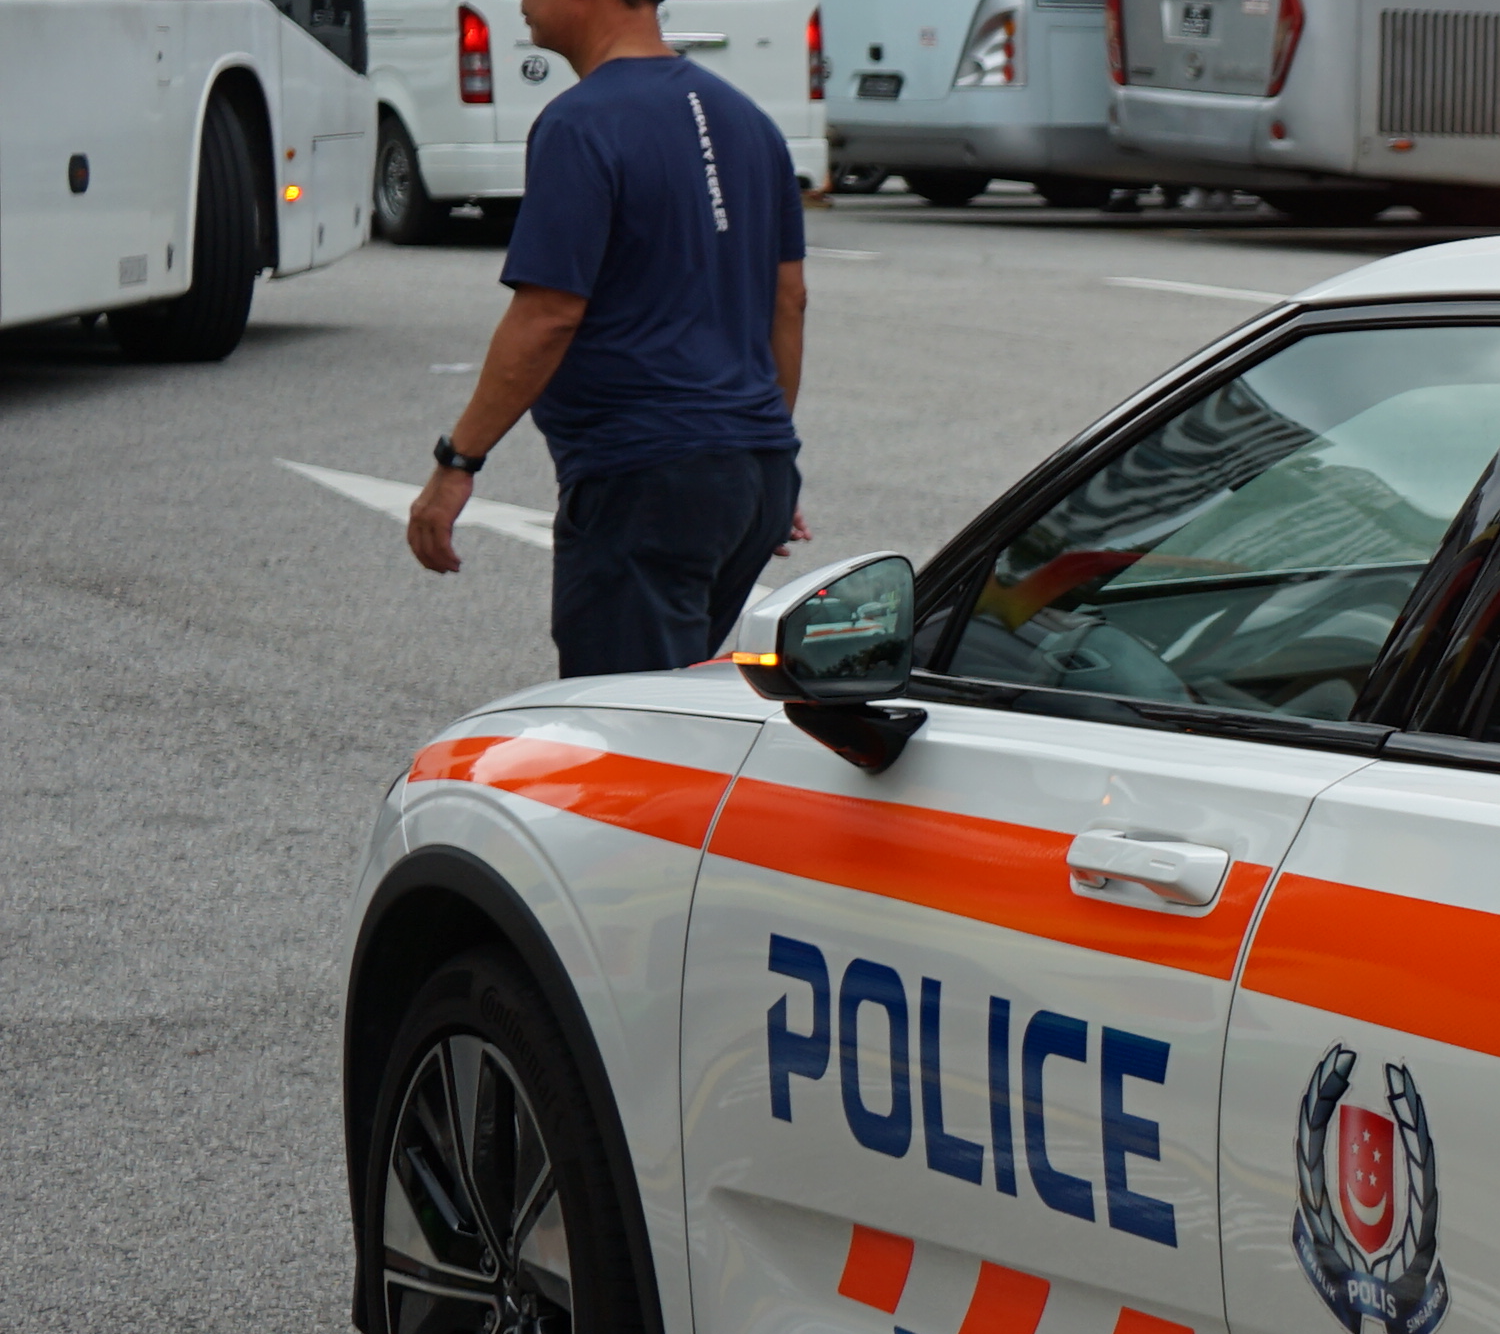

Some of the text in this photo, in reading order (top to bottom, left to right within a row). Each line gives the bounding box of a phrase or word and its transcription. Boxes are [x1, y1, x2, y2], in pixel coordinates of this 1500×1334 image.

[704, 163, 729, 233] KEPLER
[767, 932, 1179, 1249] POLICE
[1347, 1278, 1398, 1319] POLIS
[1406, 1279, 1445, 1334] SINGAPURA
